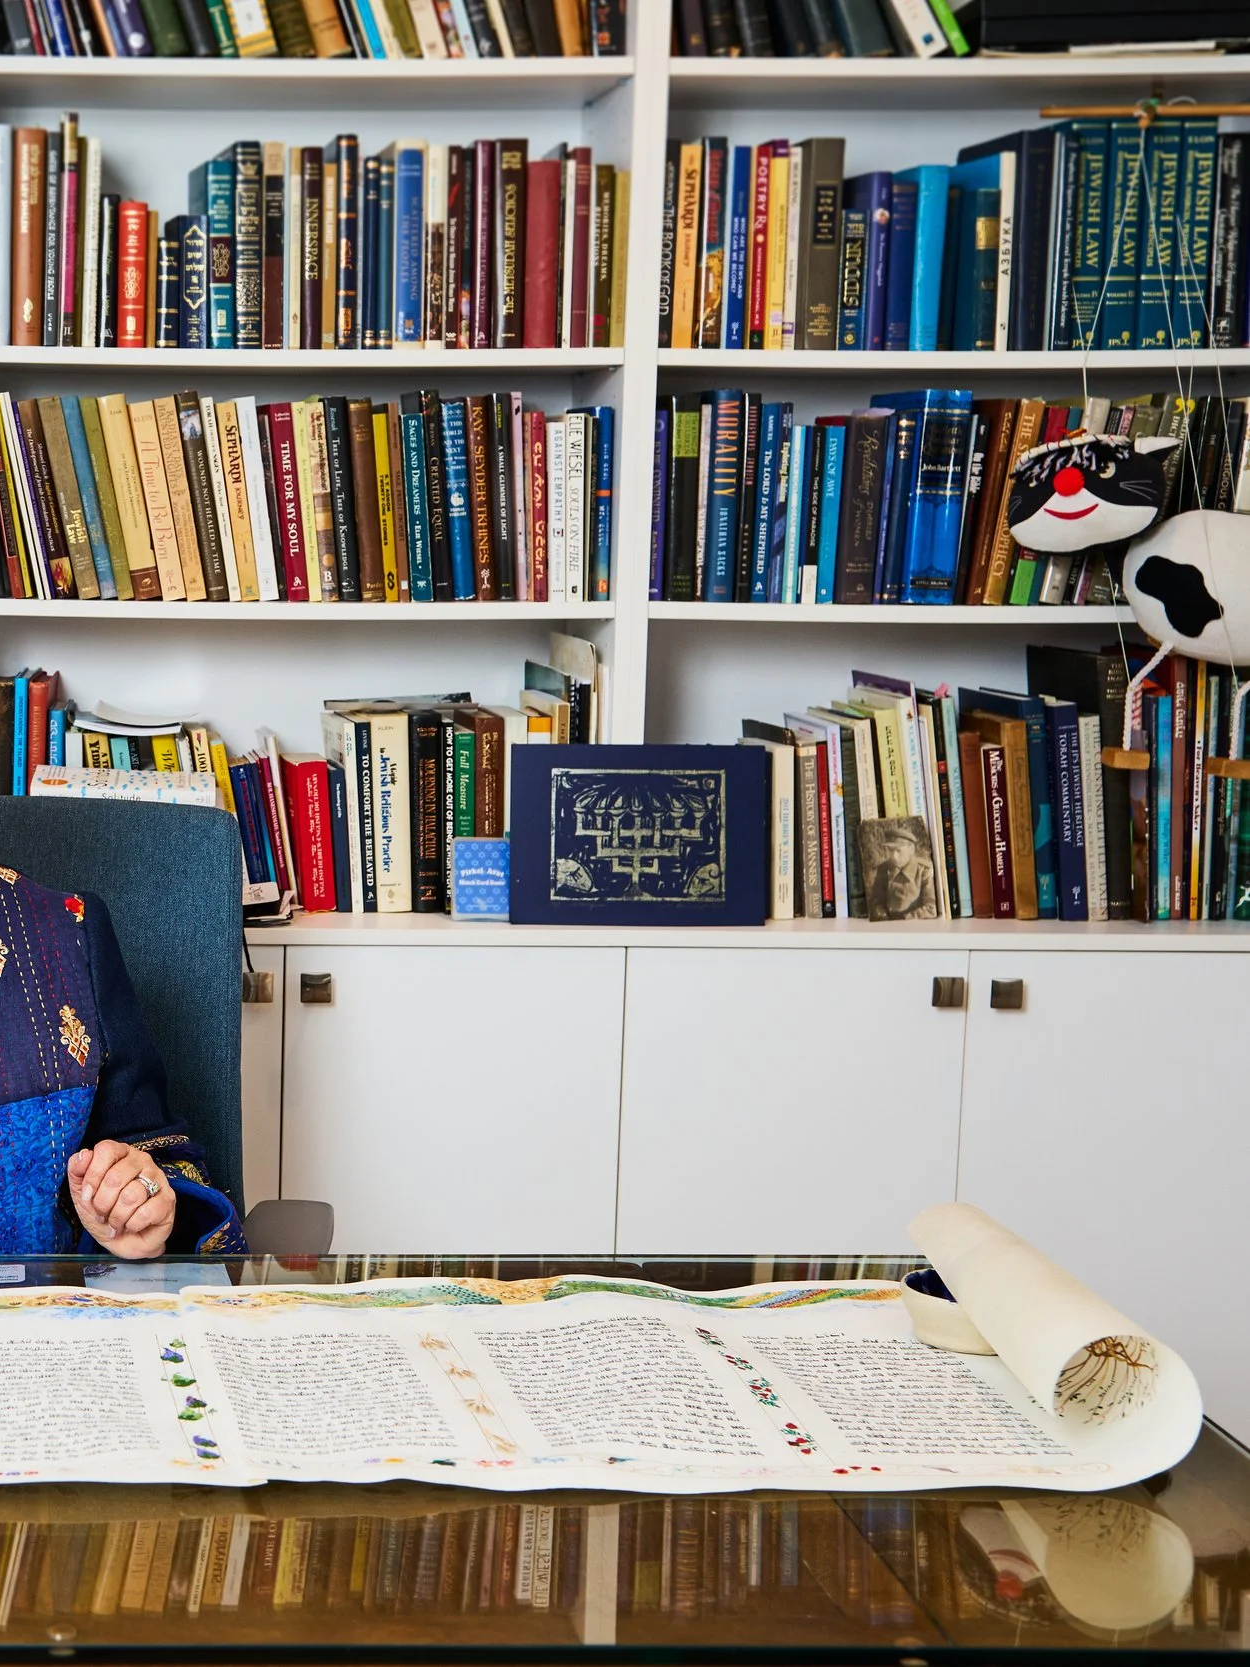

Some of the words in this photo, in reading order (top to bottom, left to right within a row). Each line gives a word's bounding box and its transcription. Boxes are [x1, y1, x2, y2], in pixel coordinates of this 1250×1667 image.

[757, 157, 768, 211] POETRY
[1086, 153, 1103, 222] JEWISH
[1194, 153, 1214, 220] JEWISH
[305, 199, 319, 280] INNERSPACE
[1085, 229, 1100, 267] LAW
[1193, 227, 1208, 266] LAW
[409, 419, 418, 448] SAGES
[472, 406, 483, 434] KAY
[568, 416, 582, 437] ELIE
[140, 440, 158, 451] A
[224, 425, 242, 484] SEPHARDI
[280, 440, 292, 474] TIME
[331, 437, 341, 457] TREE
[411, 450, 419, 468] AND
[554, 429, 563, 472] AGAINST
[568, 439, 582, 481] WIESEL
[713, 400, 740, 497] MORALITY
[764, 450, 772, 466] The
[144, 459, 163, 487] Time
[196, 450, 208, 486] WOUNDS
[334, 458, 341, 468] OF
[473, 445, 488, 501] SEYDER
[202, 488, 211, 504] NOT
[283, 477, 293, 500] FOR
[334, 470, 343, 491] LIFE,
[411, 469, 421, 515] DREAMERS
[430, 457, 442, 504] CREATED
[762, 468, 771, 494] LORD
[148, 491, 164, 503] to
[285, 502, 296, 520] MY
[336, 492, 345, 511] TREE
[554, 477, 563, 522] EMPATHY
[570, 486, 579, 521] SOULS
[760, 506, 768, 520] MY
[71, 509, 86, 543] Jewish
[151, 505, 171, 523] Be
[205, 507, 216, 540] HEALED
[338, 513, 345, 523] OF
[432, 508, 443, 543] EQUAL
[718, 507, 729, 547] JONATHAN
[66, 524, 79, 545] Law
[157, 528, 175, 560] Born
[287, 523, 299, 556] SOUL
[339, 525, 348, 571] KNOWLEDGE
[414, 525, 422, 539] ELIE
[477, 506, 490, 564] TKHINES
[570, 524, 579, 541] ON
[757, 522, 767, 574] SHEPHERD
[212, 553, 222, 574] TIME
[415, 540, 424, 564] WIESEL
[569, 544, 579, 571] FIRE
[716, 550, 729, 576] SACKS
[445, 726, 453, 745] HOW
[445, 746, 453, 757] TO
[1059, 732, 1069, 769] TORAH
[1070, 732, 1079, 748] THE
[362, 754, 369, 768] TO
[380, 755, 391, 787] Jewish
[445, 758, 453, 772] GET
[459, 750, 470, 768] Full
[803, 759, 815, 780] THE
[362, 769, 372, 816] COMFORT
[445, 773, 453, 794] MORE
[459, 772, 470, 810] Measure
[1073, 765, 1081, 799] JEWISH
[380, 790, 393, 834] Religious
[445, 795, 453, 810] OUT
[445, 811, 453, 820] OF
[805, 783, 816, 821] HISTORY
[1060, 771, 1071, 843] COMMENTARY
[364, 817, 372, 836] THE
[807, 823, 817, 838] OF
[1073, 802, 1084, 847] HERITAGE
[364, 838, 374, 886] BEREAVED
[382, 835, 392, 873] Practice
[807, 840, 818, 885] MANNERS
[995, 841, 1006, 876] HAMELN
